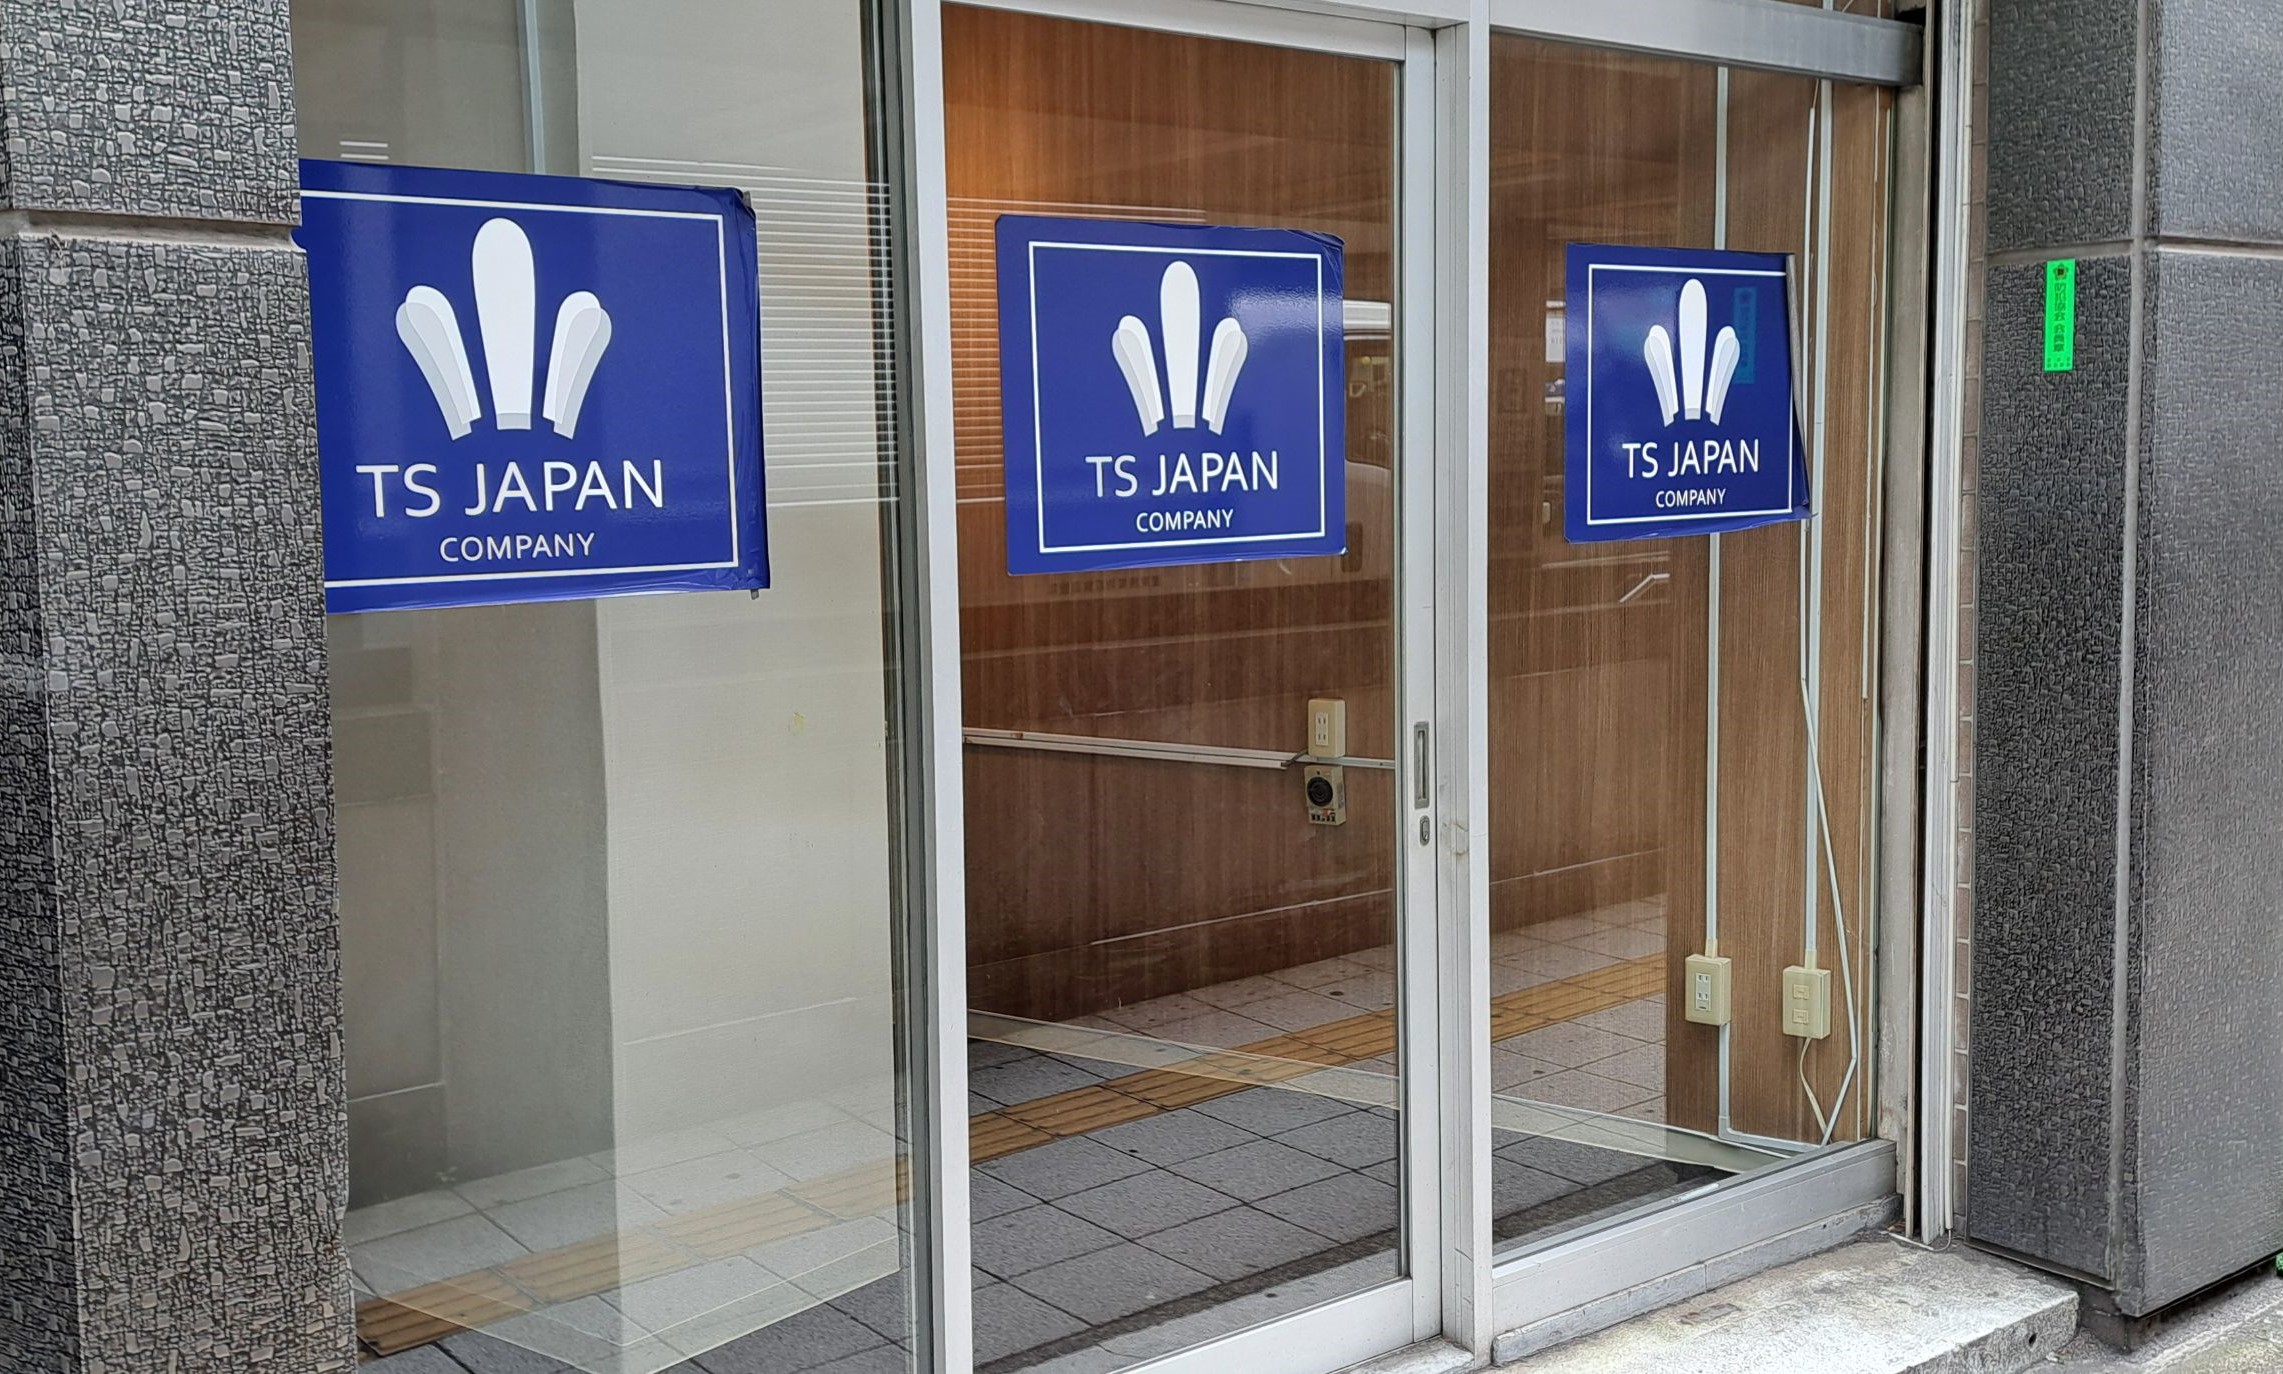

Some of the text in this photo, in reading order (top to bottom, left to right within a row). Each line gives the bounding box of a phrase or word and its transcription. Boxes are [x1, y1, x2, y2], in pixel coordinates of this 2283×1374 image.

[1085, 450, 1279, 498] TS JAPAN
[1621, 438, 1759, 480] TS JAPAN
[355, 459, 664, 519] TS JAPAN
[1655, 488, 1727, 508] COMPANY
[1136, 508, 1235, 533] COMPANY
[440, 532, 596, 563] COMPANY
